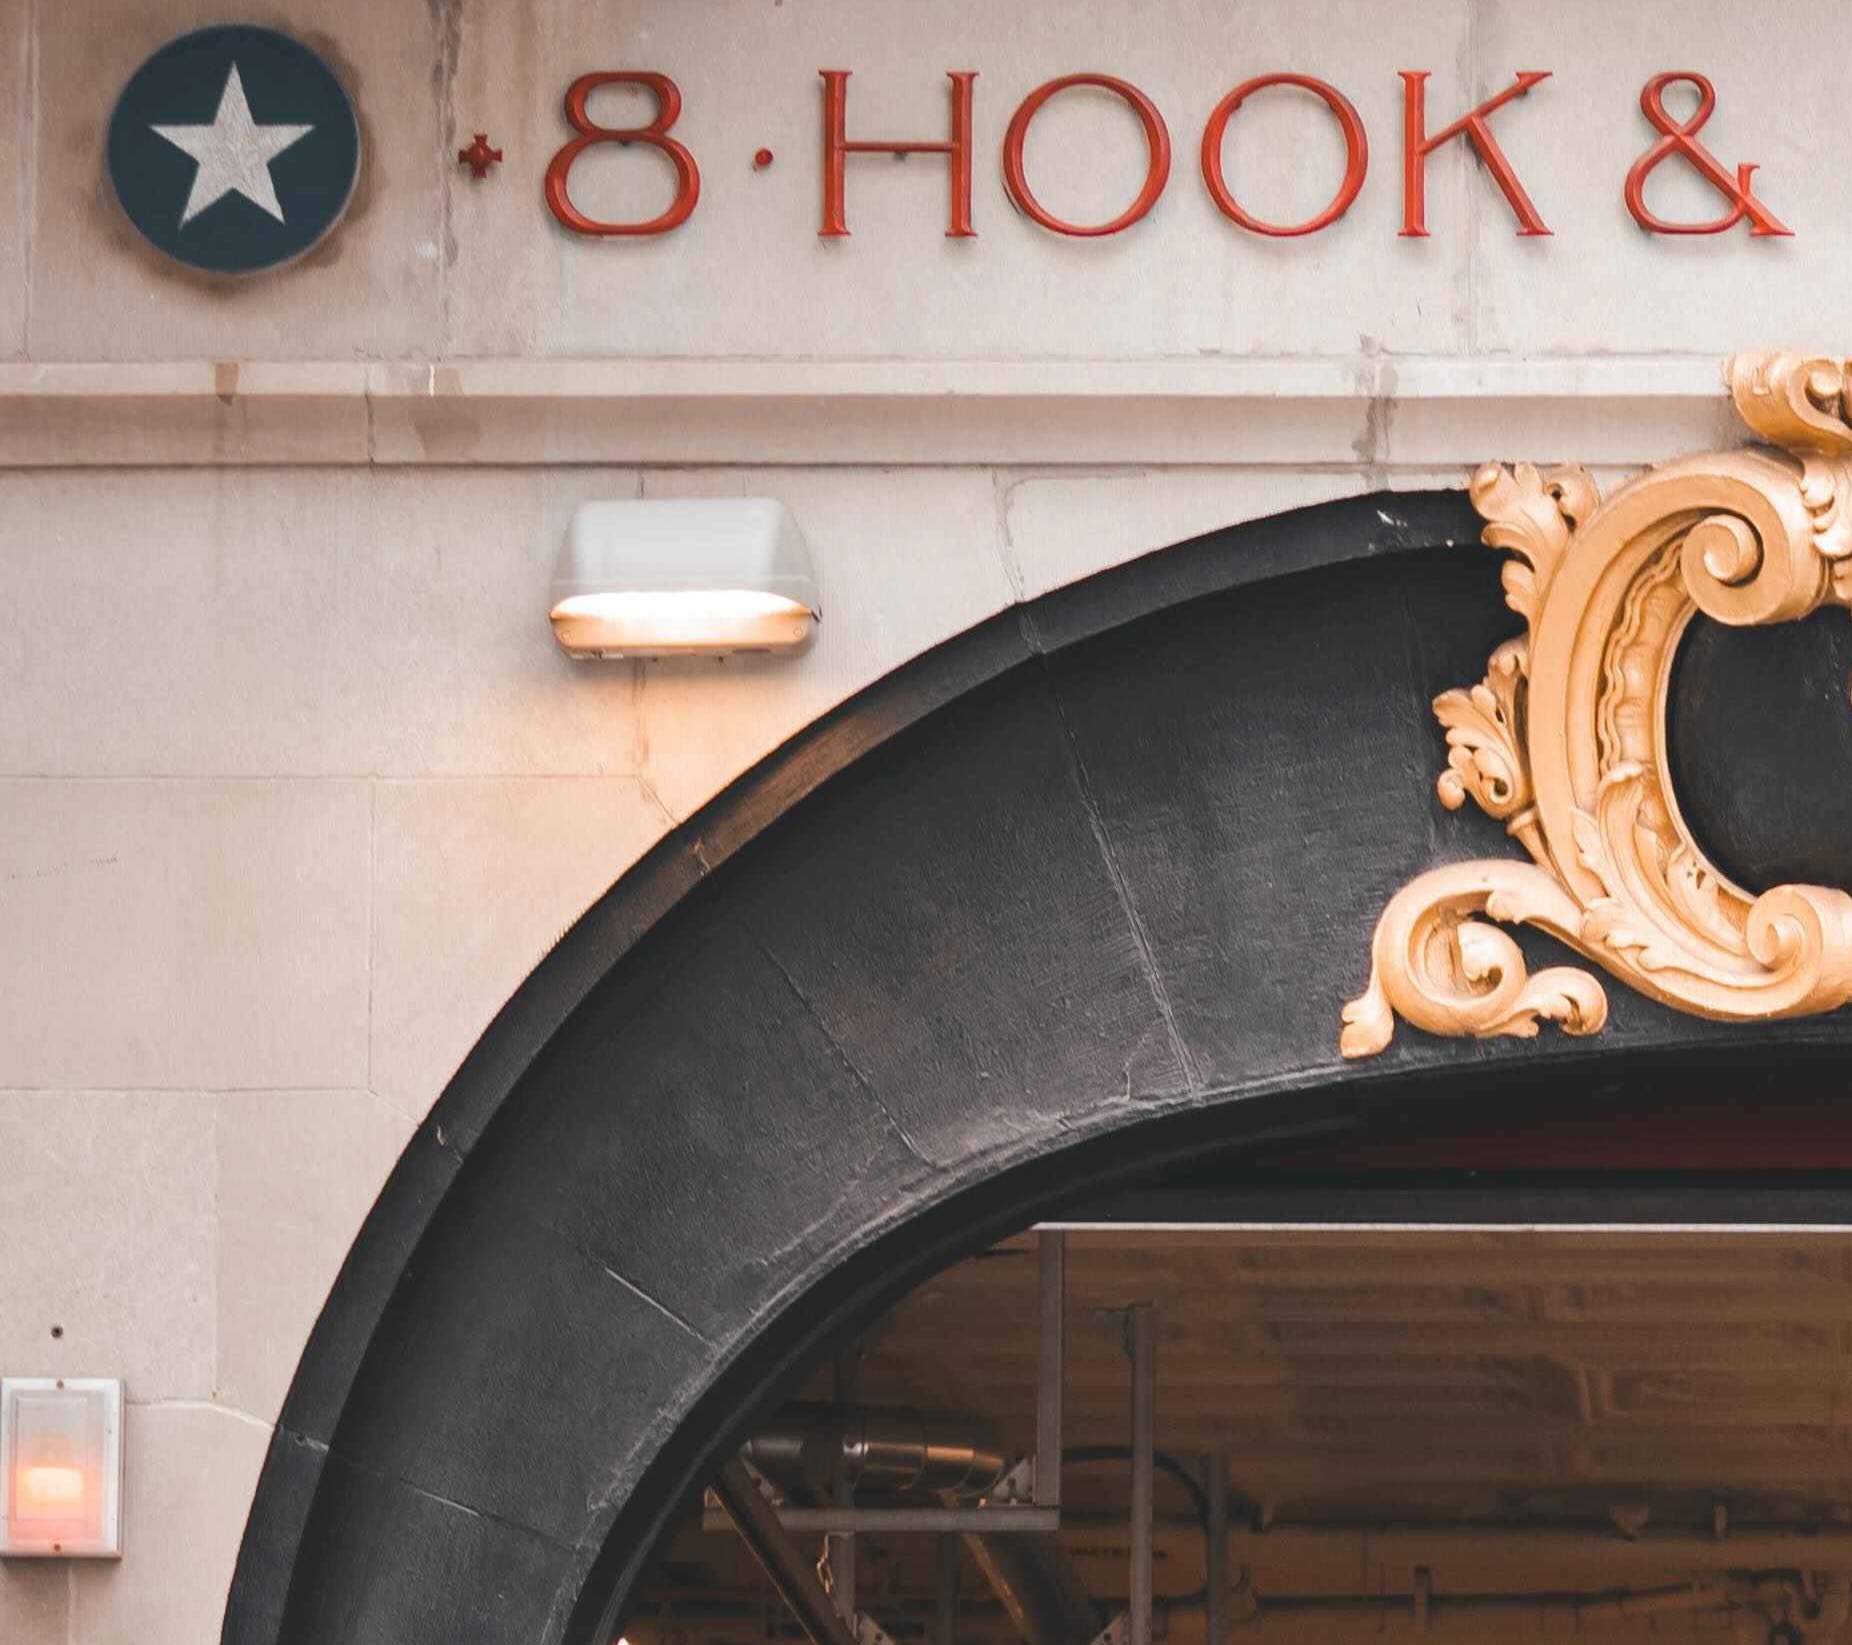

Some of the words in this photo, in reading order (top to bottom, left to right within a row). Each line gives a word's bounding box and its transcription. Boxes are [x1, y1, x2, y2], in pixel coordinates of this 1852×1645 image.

[545, 70, 701, 236] 8
[818, 70, 1555, 238] HOOK
[1624, 71, 1795, 238] &
